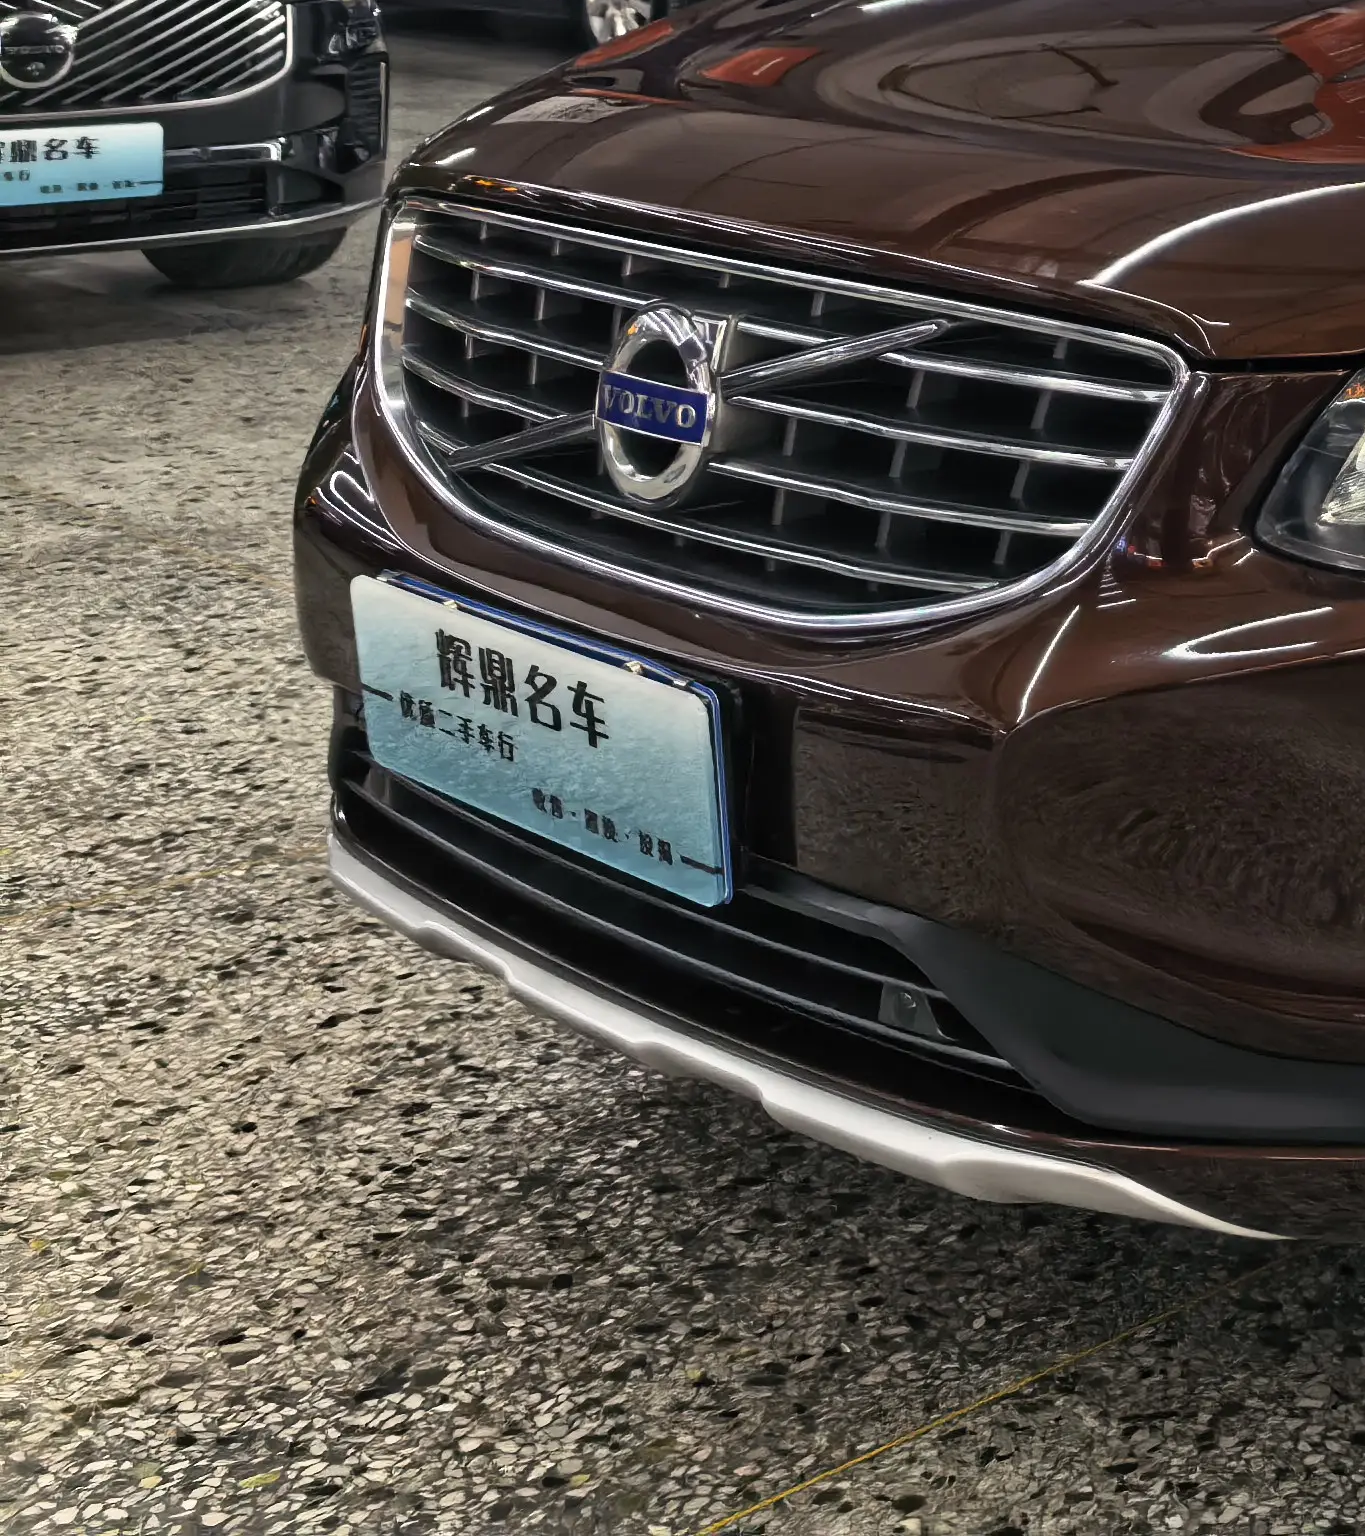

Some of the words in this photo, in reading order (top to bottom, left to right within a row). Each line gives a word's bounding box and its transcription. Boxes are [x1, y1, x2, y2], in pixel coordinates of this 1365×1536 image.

[602, 384, 697, 429] VOLVO
[435, 628, 609, 749] 辉鼎名车
